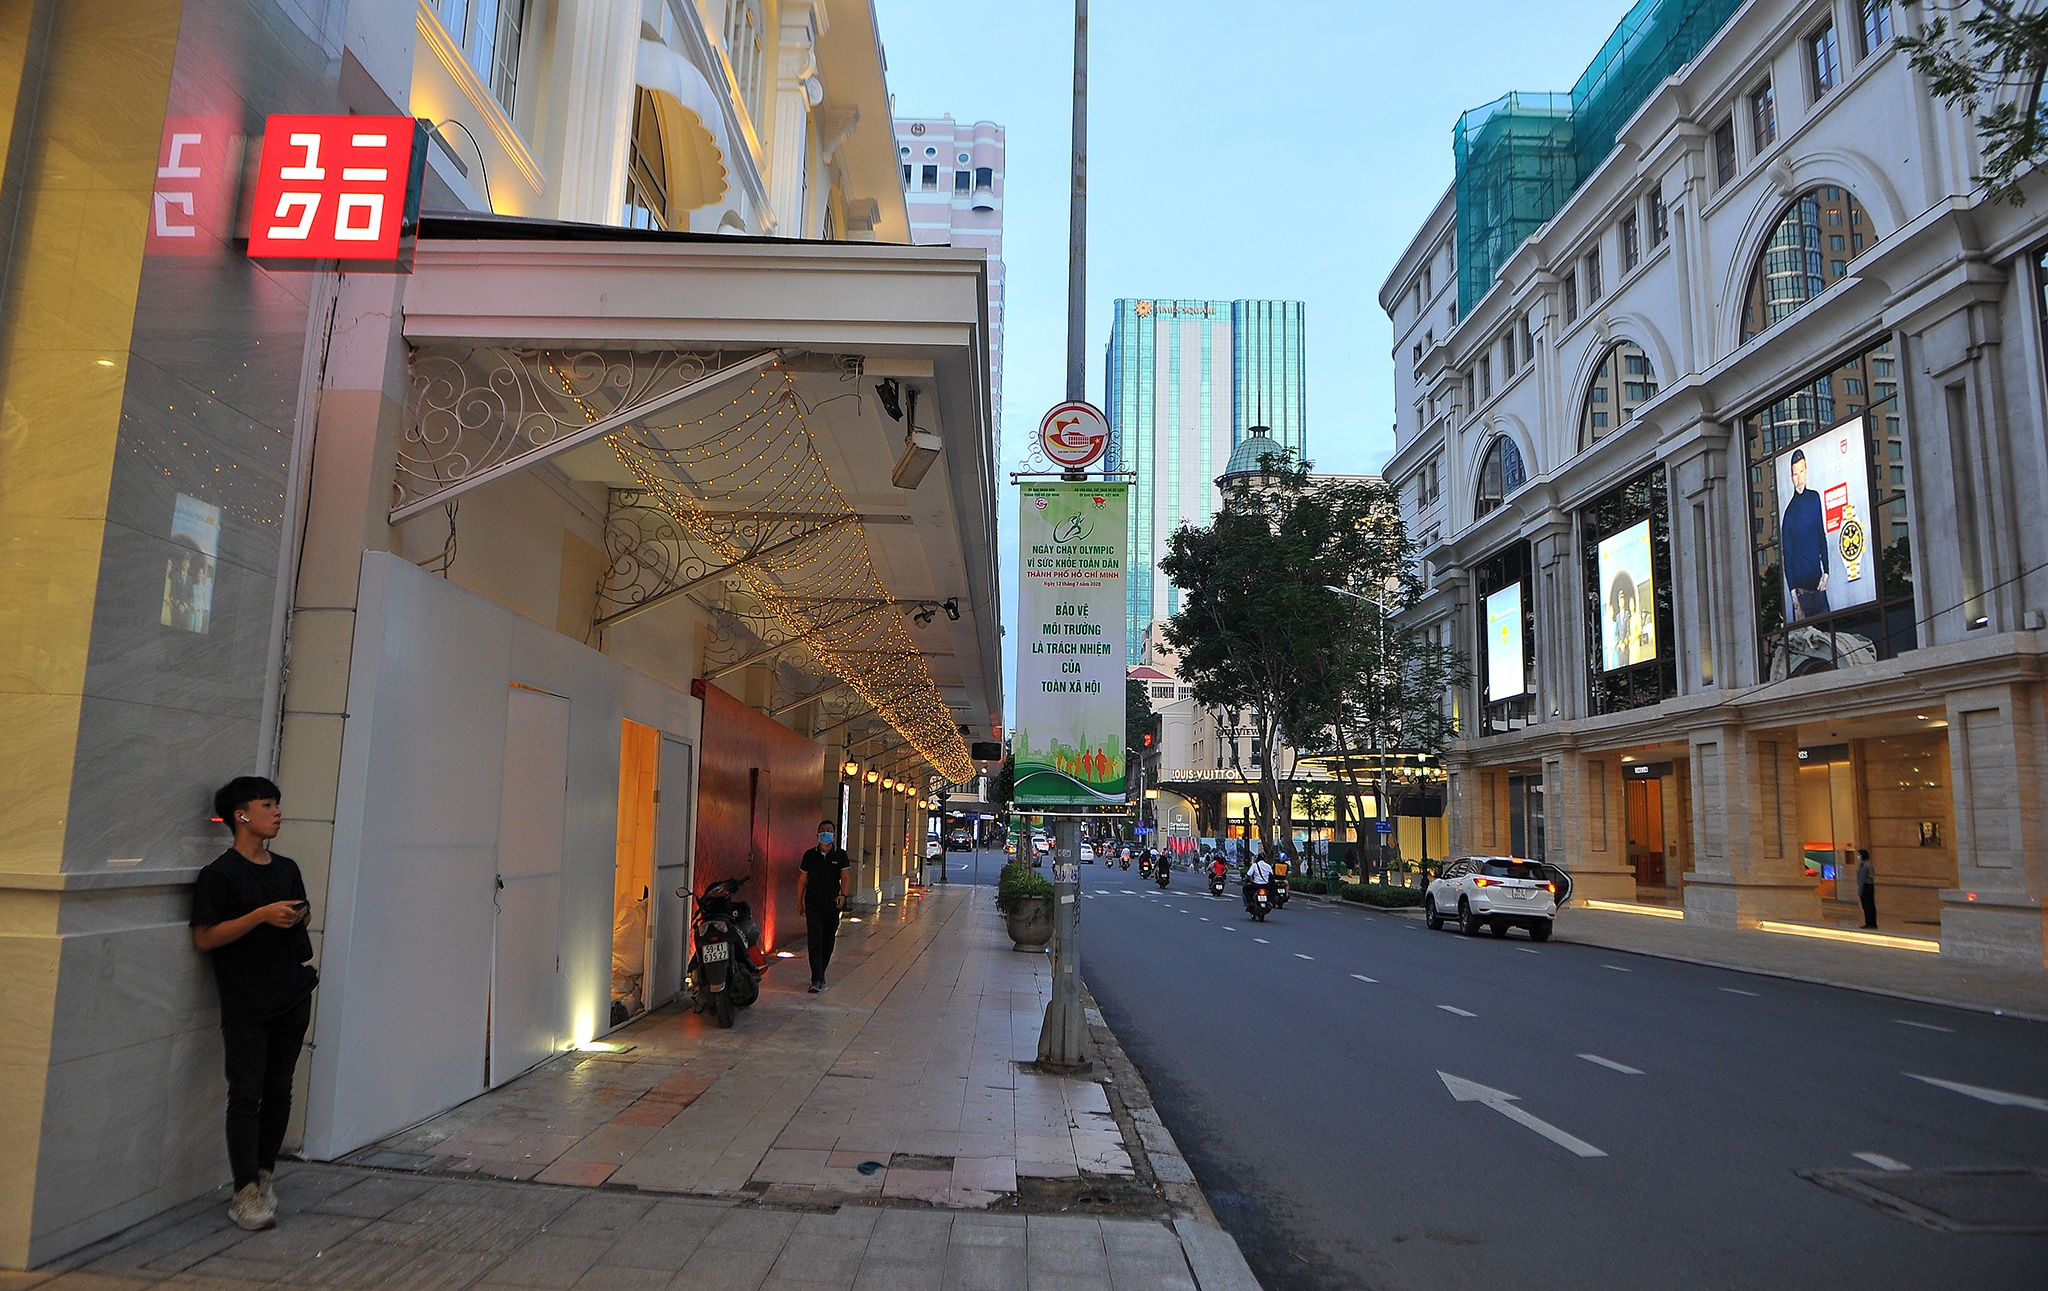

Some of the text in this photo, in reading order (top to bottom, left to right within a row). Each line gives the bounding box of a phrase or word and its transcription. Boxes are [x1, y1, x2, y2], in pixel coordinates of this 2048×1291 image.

[1182, 306, 1216, 316] SQUARE
[1032, 544, 1114, 556] NGÀY CHẠY OLYMPIC
[1027, 557, 1119, 568] VÌ SỨC KHỎE TOÀN DÂN
[1027, 570, 1052, 578] THÀNH
[1054, 570, 1070, 578] PHỐ
[1084, 570, 1098, 578] CHÍ
[1100, 571, 1119, 579] MINH
[1055, 602, 1089, 618] BẢO VỆ
[1043, 622, 1101, 635] MÔI TRƯỜNG
[1032, 640, 1111, 657] LÀ TRÁCH NHIỆM
[1062, 659, 1081, 673] CỦA
[1041, 679, 1101, 695] TOÀN XÃ HỘI
